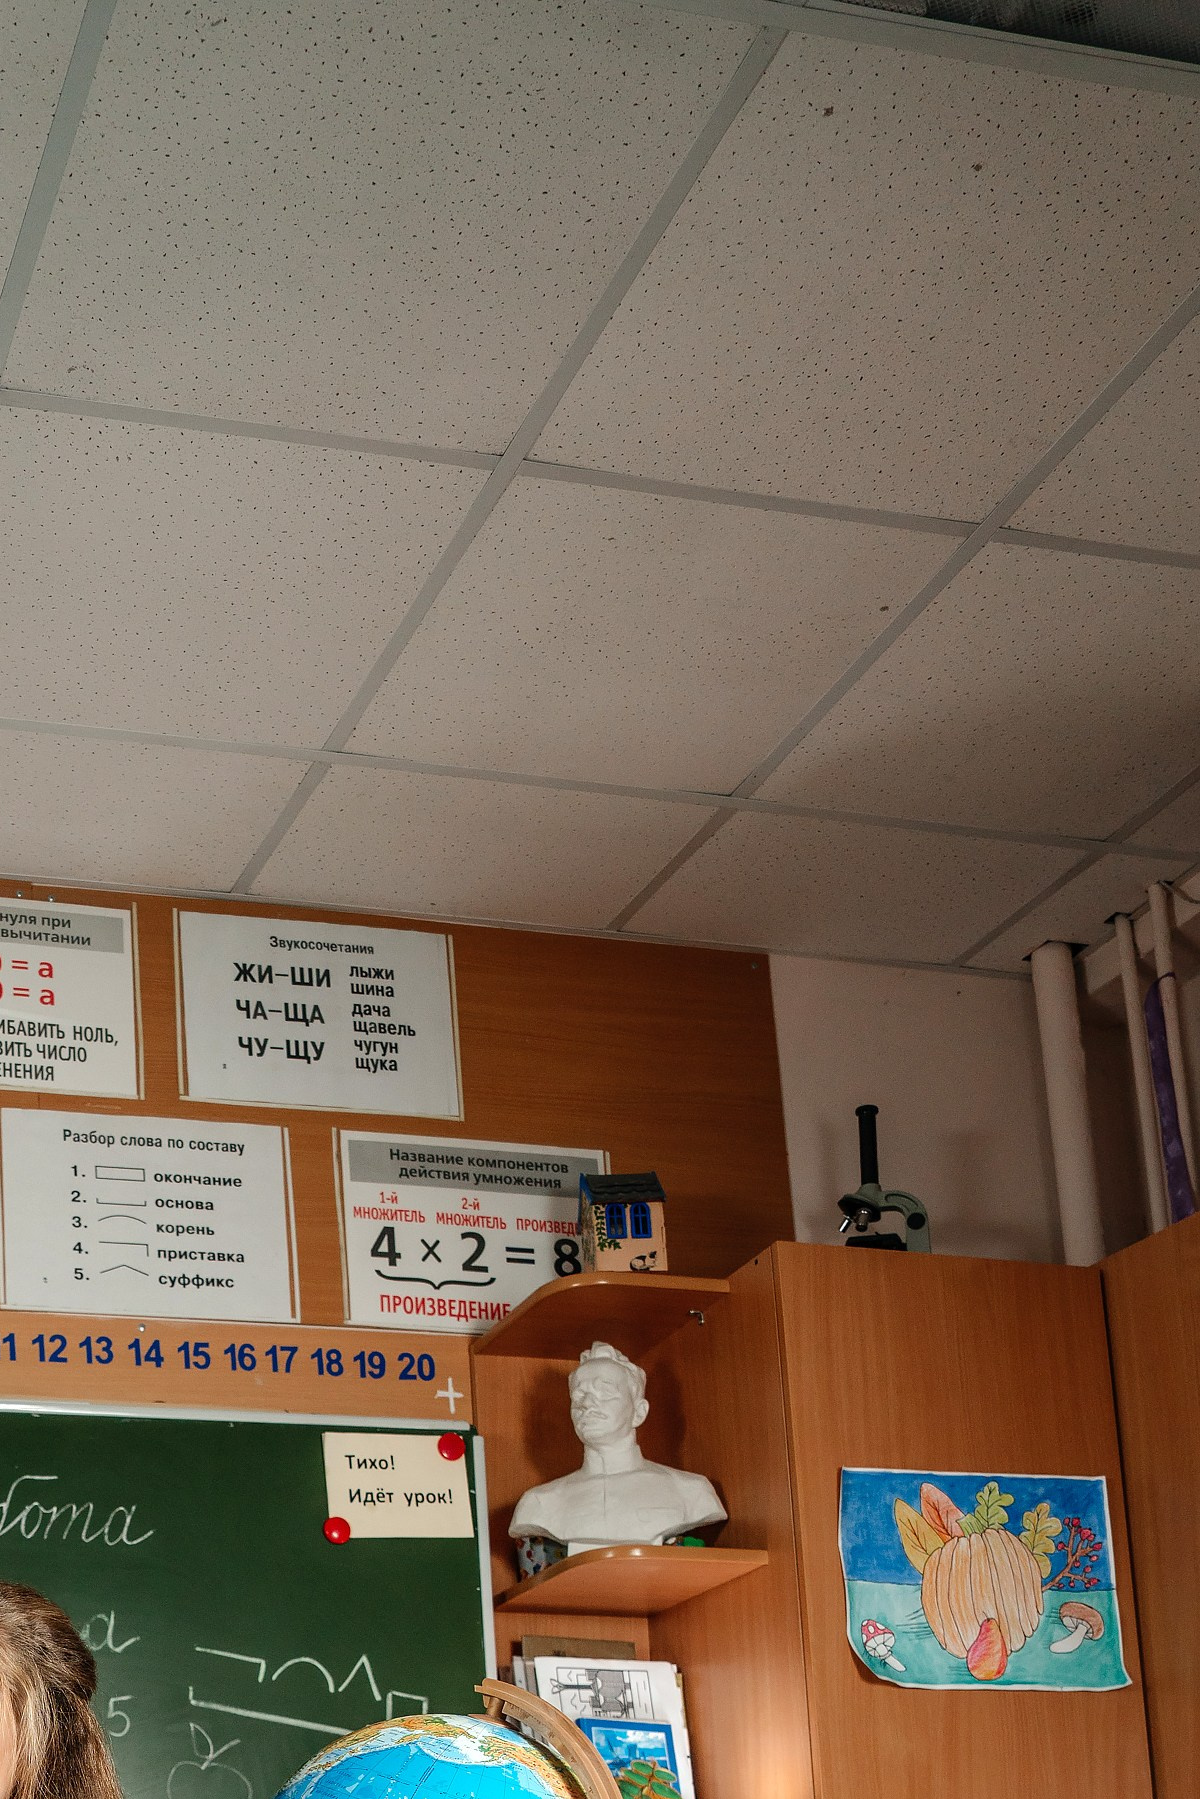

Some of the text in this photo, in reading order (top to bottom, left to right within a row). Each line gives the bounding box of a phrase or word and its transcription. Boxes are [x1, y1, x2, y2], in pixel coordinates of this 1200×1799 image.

[0, 913, 36, 926] нуля
[41, 917, 71, 930] при
[1, 928, 90, 946] вычитании
[269, 936, 374, 954] Звукосочетания
[349, 966, 394, 980] лыжи
[350, 983, 394, 997] шина
[352, 1003, 391, 1018] дача
[73, 1026, 118, 1046] НОЛЬ,
[353, 1021, 416, 1036] щавель
[36, 1043, 87, 1062] ЧИСЛО
[354, 1039, 398, 1056] чугун
[355, 1057, 398, 1074] щука
[63, 1129, 245, 1156] Разбор слова по составу
[389, 1148, 568, 1173] Название компонентов
[154, 1173, 242, 1187] окончание
[399, 1167, 561, 1189] действия умножения
[155, 1198, 214, 1210] основа
[380, 1191, 480, 1211] 1-й 2-й
[353, 1206, 426, 1223] МНОЖИТЕЛЬ
[436, 1212, 507, 1230] МНОЖИТЕЛЬ
[156, 1224, 215, 1236] корень
[157, 1249, 244, 1263] приставка
[158, 1274, 234, 1289] суффикс
[32, 1335, 67, 1362] 12
[80, 1336, 113, 1364] 13
[128, 1339, 164, 1367] 14
[178, 1342, 210, 1369] 15
[224, 1344, 256, 1371] 16
[265, 1345, 298, 1372] 17
[311, 1348, 343, 1376] 18
[354, 1351, 385, 1379] 19
[398, 1353, 434, 1381] 20
[345, 1455, 395, 1470] Тихо!
[348, 1488, 453, 1507] Идёт урок!
